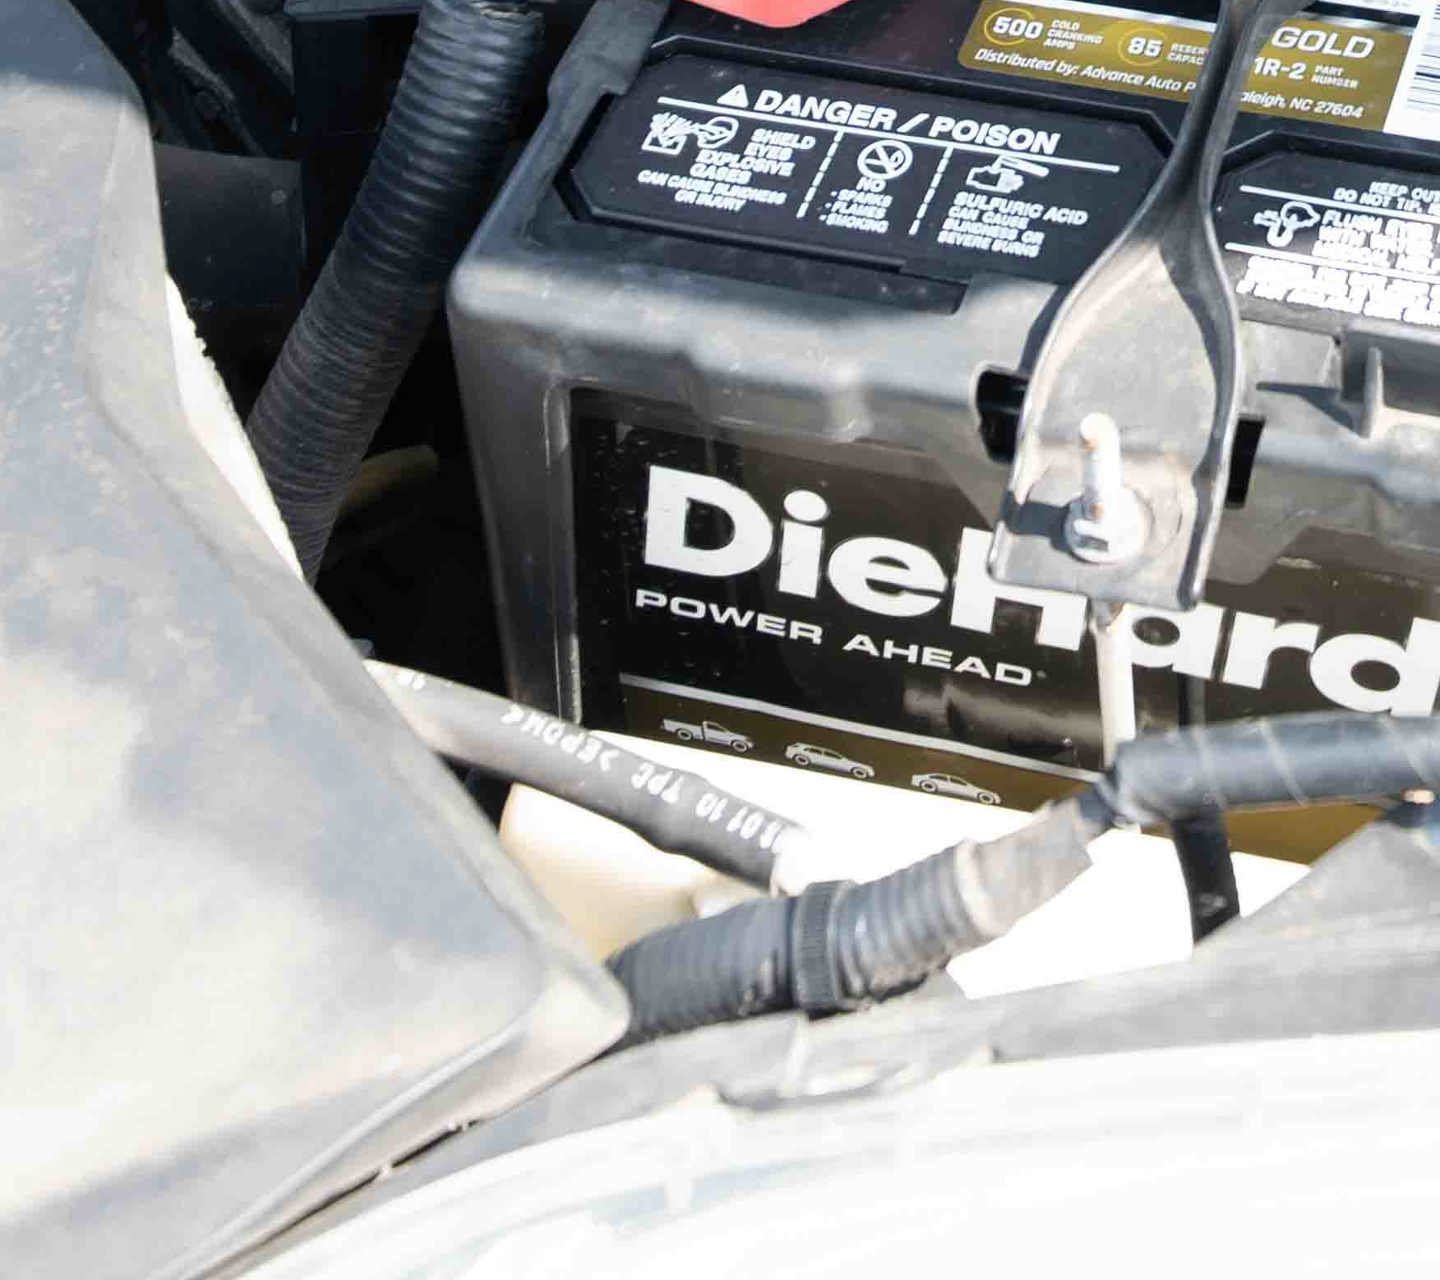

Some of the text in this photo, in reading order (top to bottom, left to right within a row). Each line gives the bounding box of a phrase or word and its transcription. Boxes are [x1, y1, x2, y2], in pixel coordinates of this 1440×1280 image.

[992, 16, 1044, 39] 500
[1051, 19, 1080, 31] COLD
[1127, 36, 1164, 57] 85
[1271, 26, 1376, 59] GOLD
[974, 48, 1058, 73] Distributed
[1058, 61, 1079, 76] by:
[1081, 65, 1144, 86] Advance
[1144, 75, 1181, 90] Auto
[1167, 52, 1205, 66] CAPAC
[1315, 64, 1344, 77] PART
[1240, 90, 1365, 119] aleigh, NC 27604
[753, 89, 898, 130] DANGER
[928, 115, 1061, 155] POISON
[750, 128, 816, 150] SHIELD
[695, 149, 796, 176] EXPLOSIVE
[743, 142, 794, 161] EYES
[689, 163, 752, 184] GASES
[856, 176, 887, 193] NO
[953, 191, 1089, 226] SULFURIC ACID
[1333, 187, 1358, 203] DO
[1359, 191, 1393, 208] NOT
[947, 204, 1031, 230] CAN CAUSE
[635, 588, 1033, 687] POWER AHEAD
